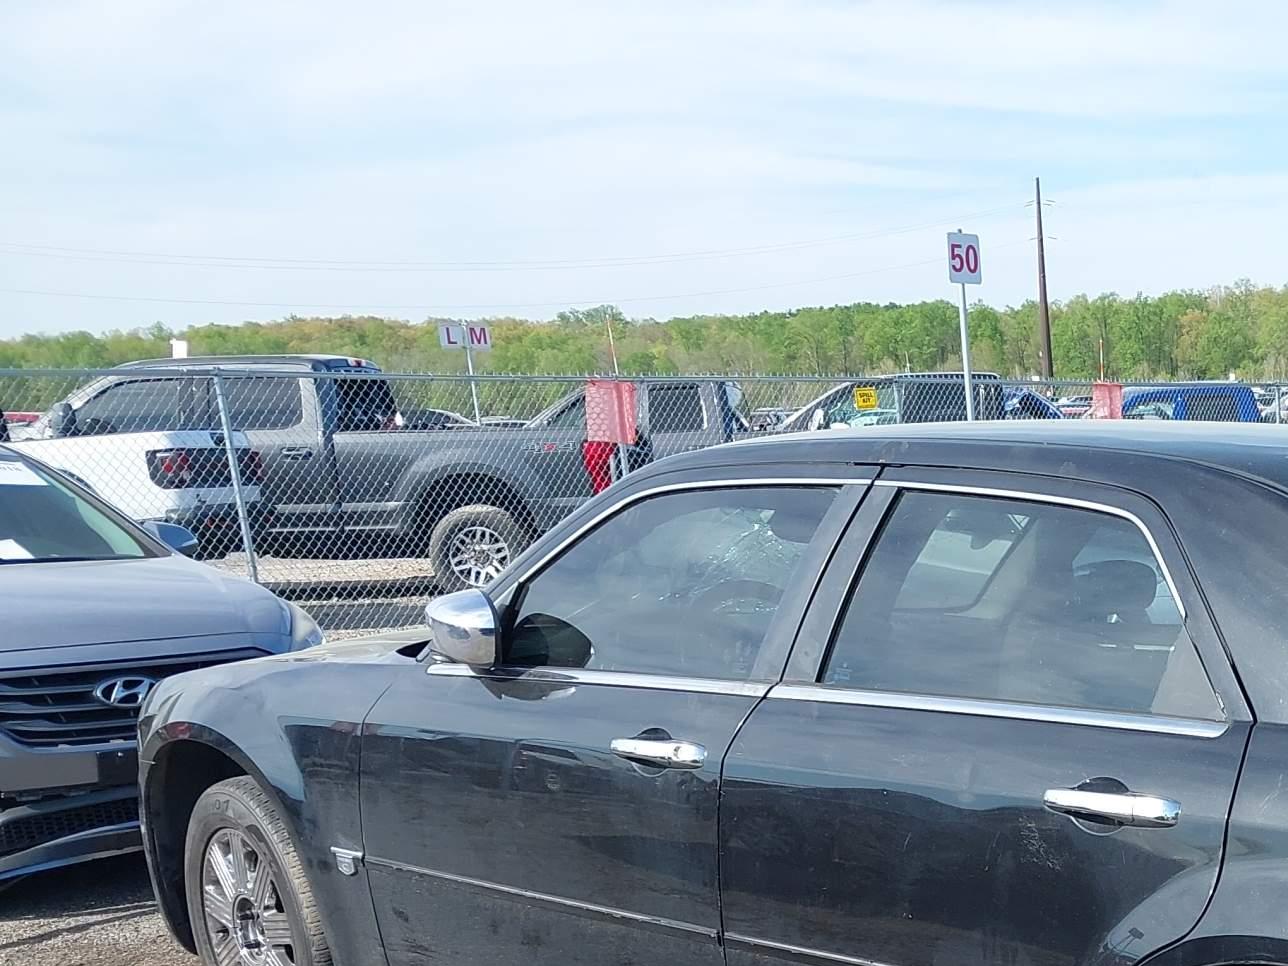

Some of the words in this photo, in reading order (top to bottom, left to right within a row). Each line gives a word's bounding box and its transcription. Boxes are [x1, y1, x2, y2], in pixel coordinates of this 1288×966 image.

[951, 243, 979, 274] 50
[445, 326, 458, 345] L
[469, 327, 488, 345] M
